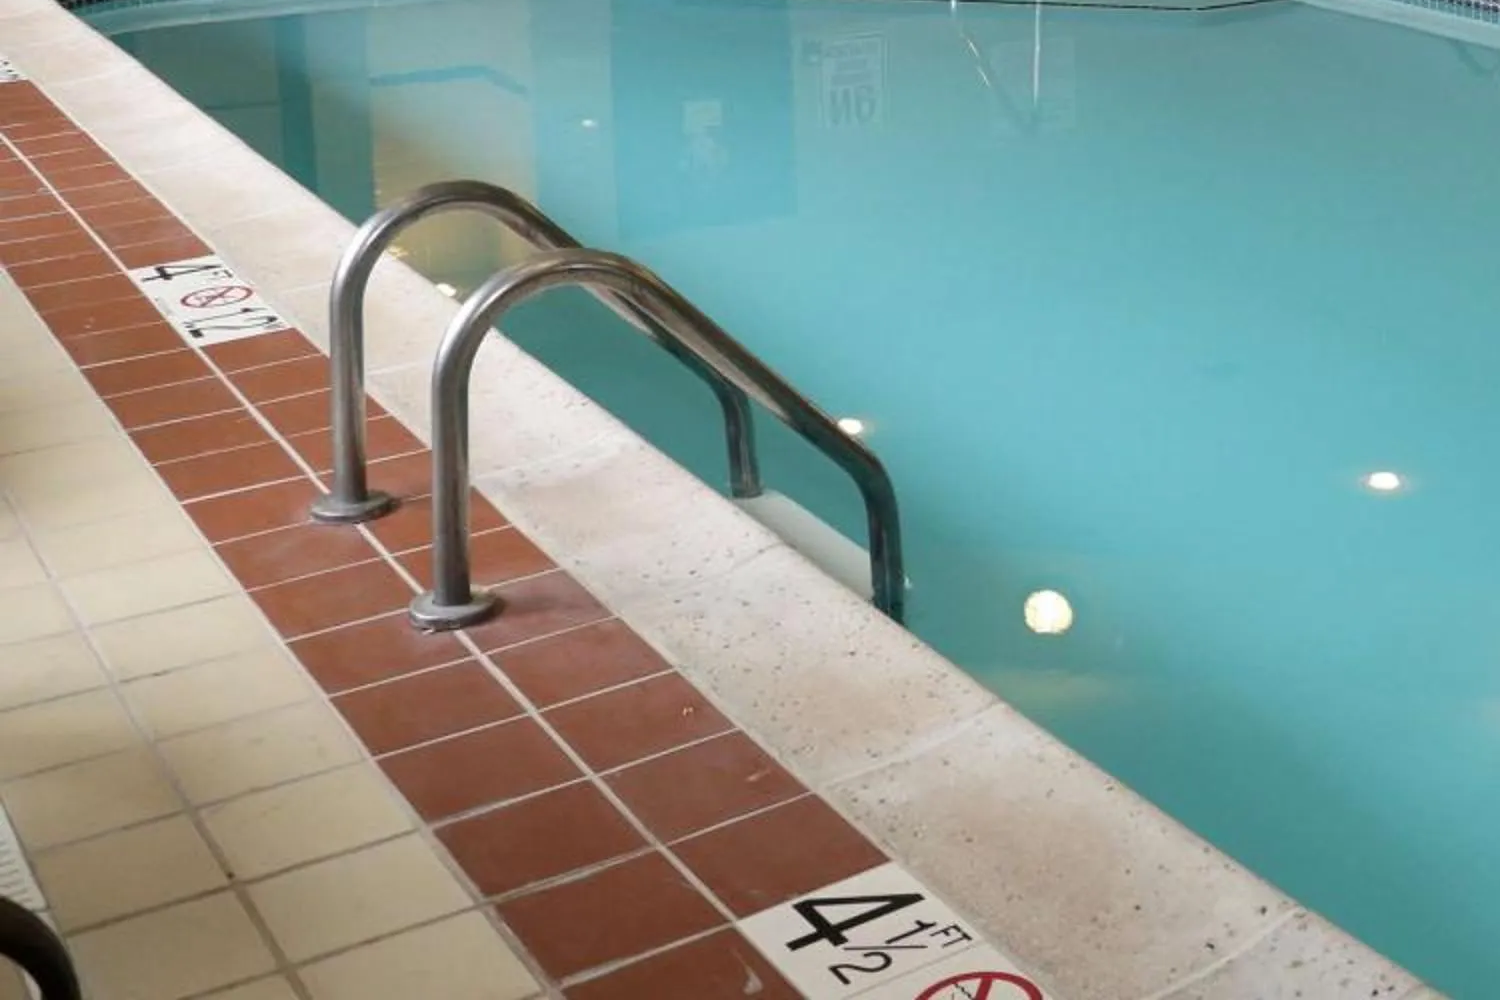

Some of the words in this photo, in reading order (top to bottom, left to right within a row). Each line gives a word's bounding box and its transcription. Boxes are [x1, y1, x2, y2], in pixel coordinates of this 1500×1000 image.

[141, 264, 222, 282] 4
[786, 893, 926, 951] 4
[930, 924, 973, 948] FT
